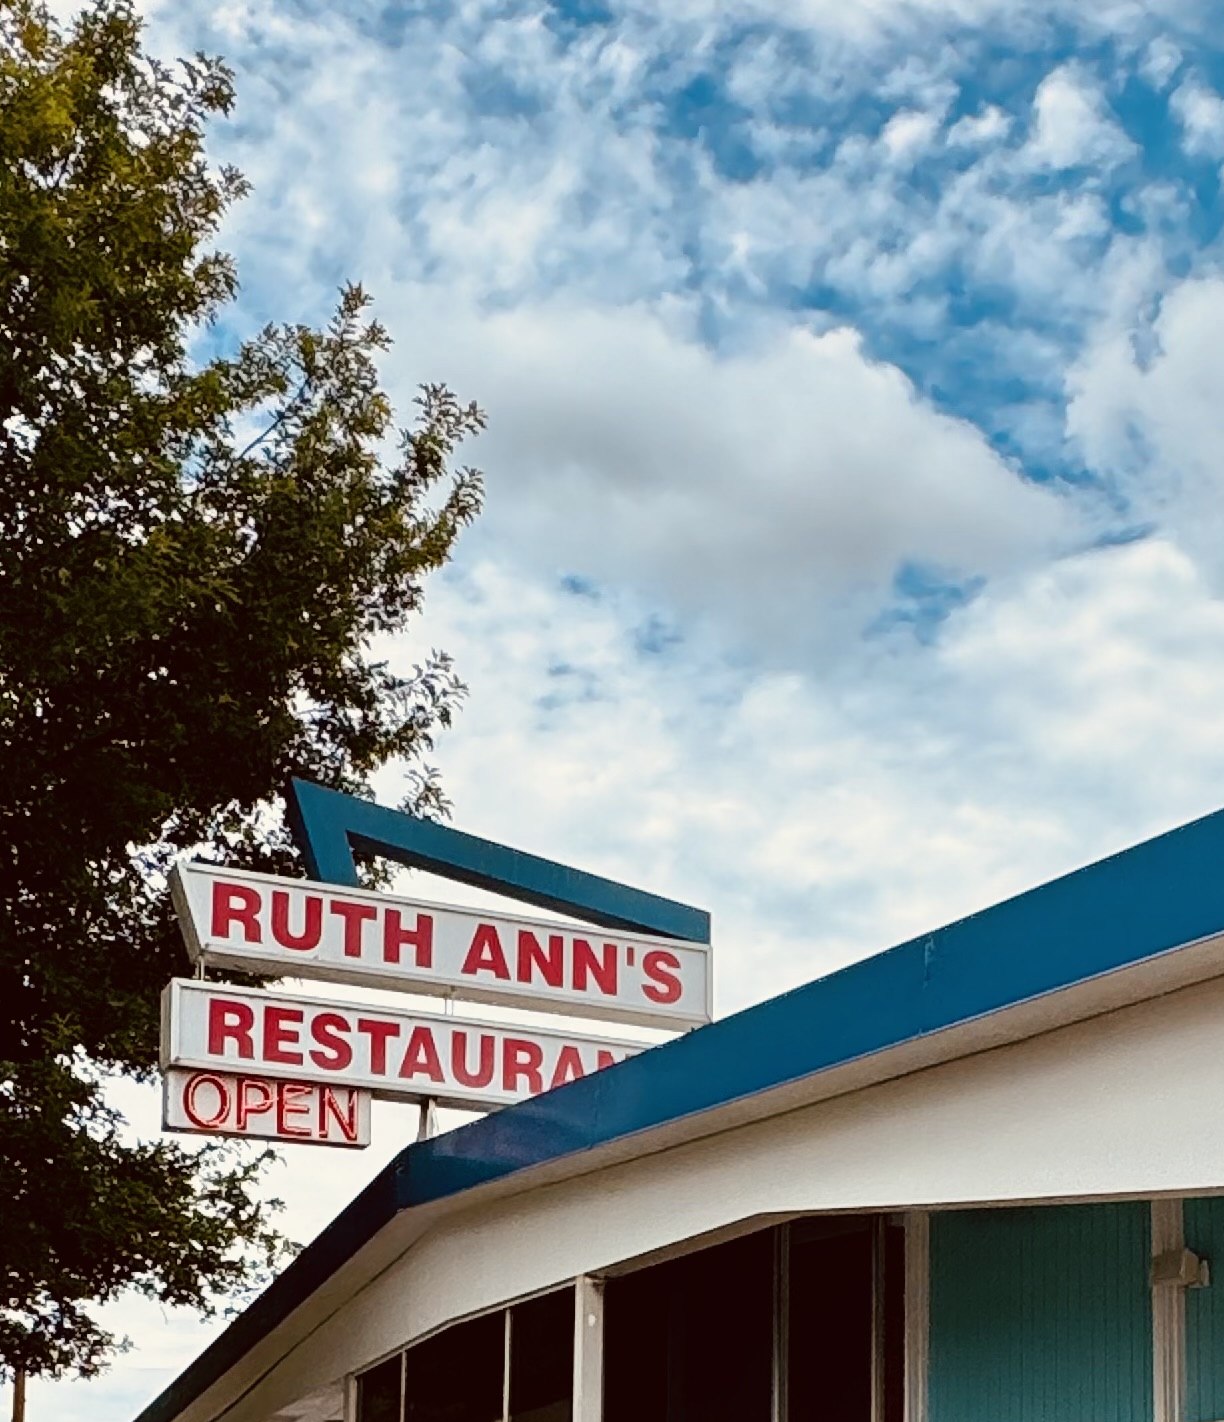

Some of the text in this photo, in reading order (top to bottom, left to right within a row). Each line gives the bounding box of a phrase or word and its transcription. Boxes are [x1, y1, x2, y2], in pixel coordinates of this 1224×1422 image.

[211, 881, 683, 1004] RUTH ANN'S
[183, 1073, 358, 1142] OPEN
